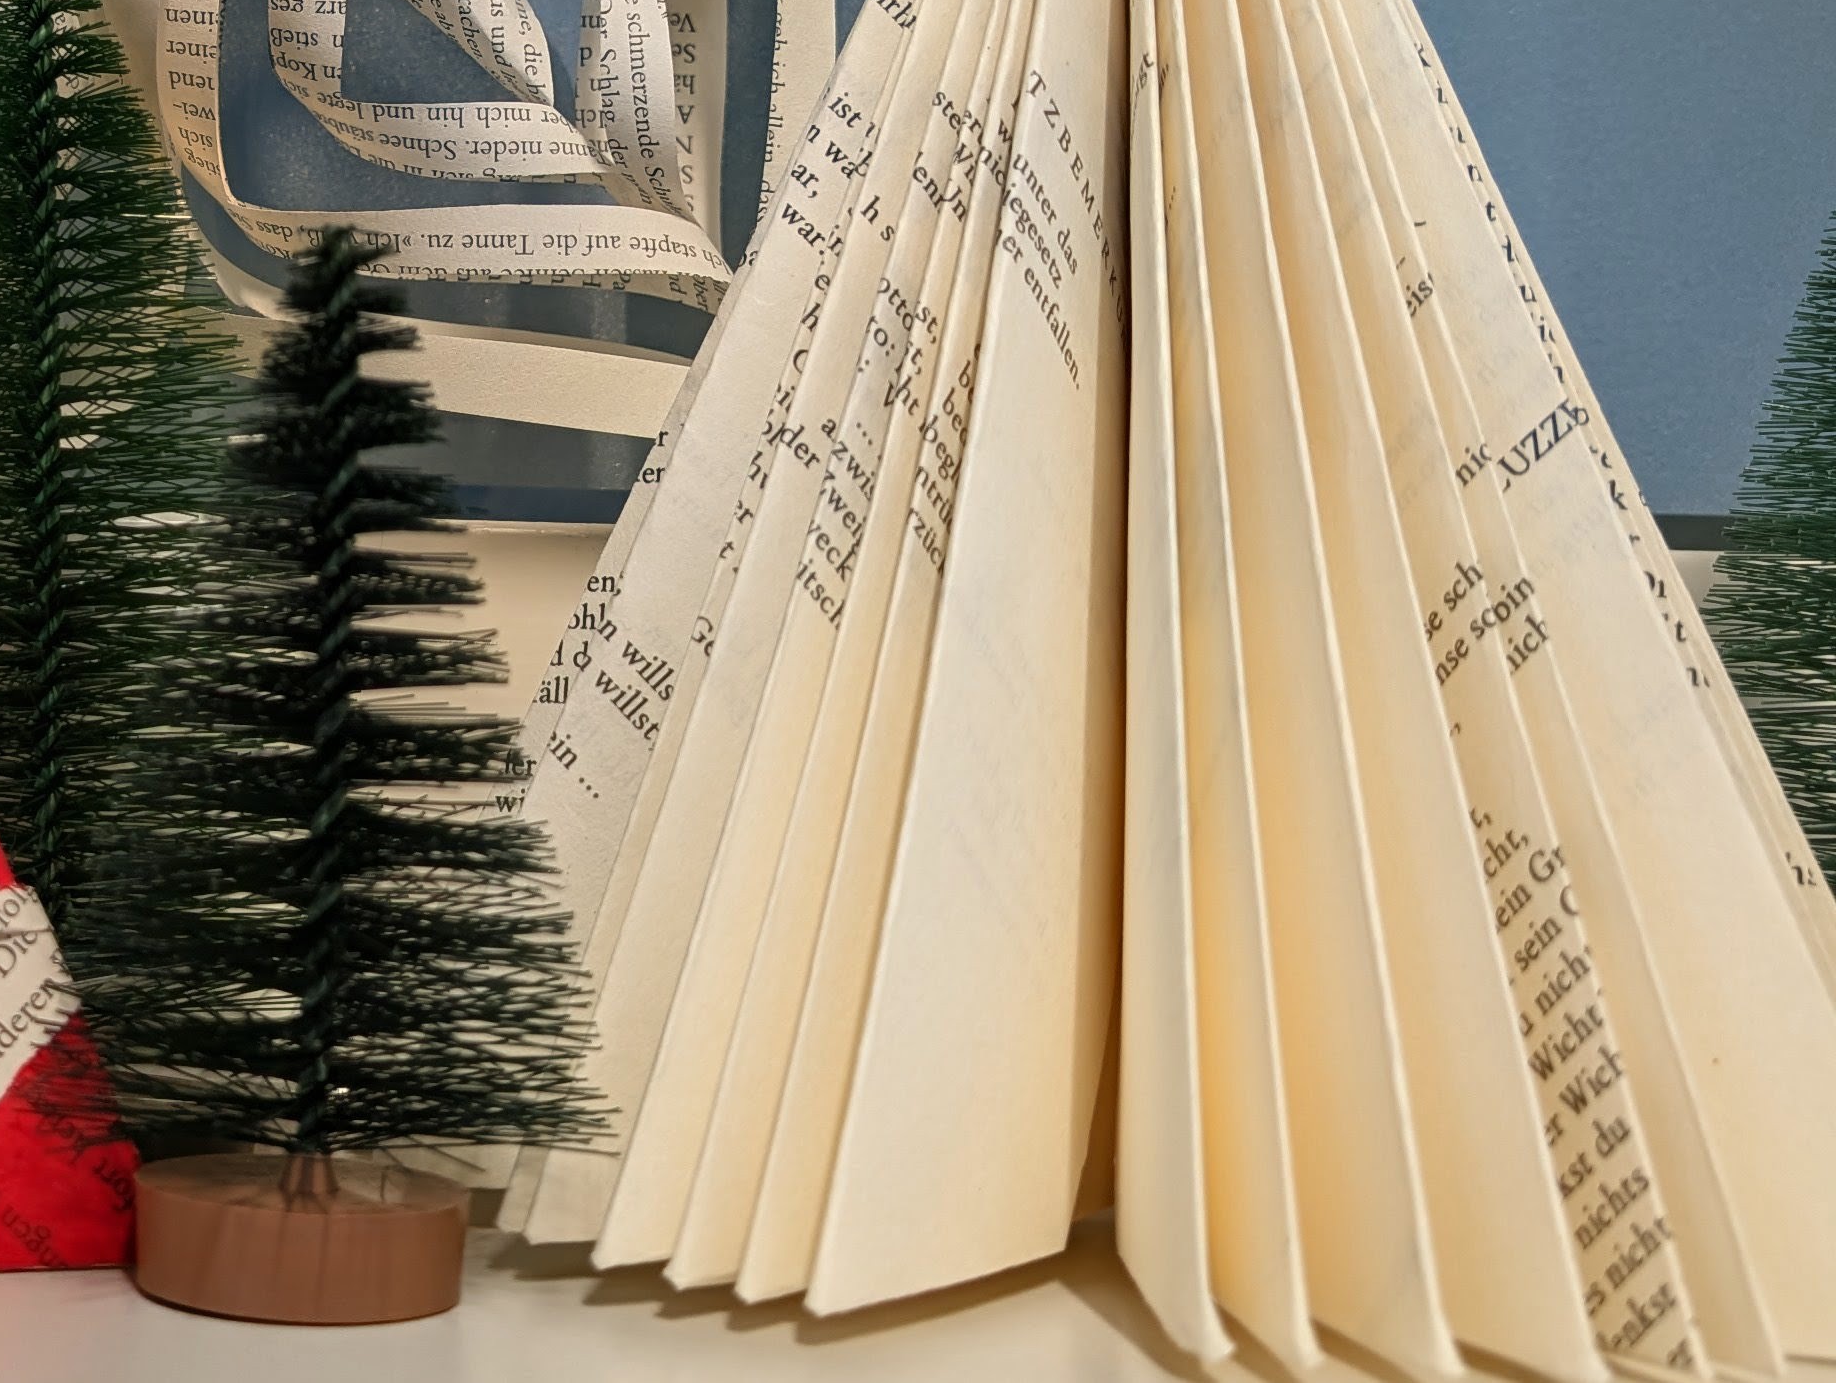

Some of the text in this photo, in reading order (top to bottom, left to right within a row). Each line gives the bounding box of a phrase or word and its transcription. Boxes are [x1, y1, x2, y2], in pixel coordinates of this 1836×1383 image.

[427, 106, 532, 125] mich hin
[626, 3, 655, 159] schmerzende
[379, 136, 543, 157] nieder. Schnee
[420, 234, 697, 263] stapfte auf die Tanne zu.
[1014, 154, 1078, 276] unter das
[1024, 268, 1082, 390] entfallen.
[1574, 1167, 1652, 1251] nichts
